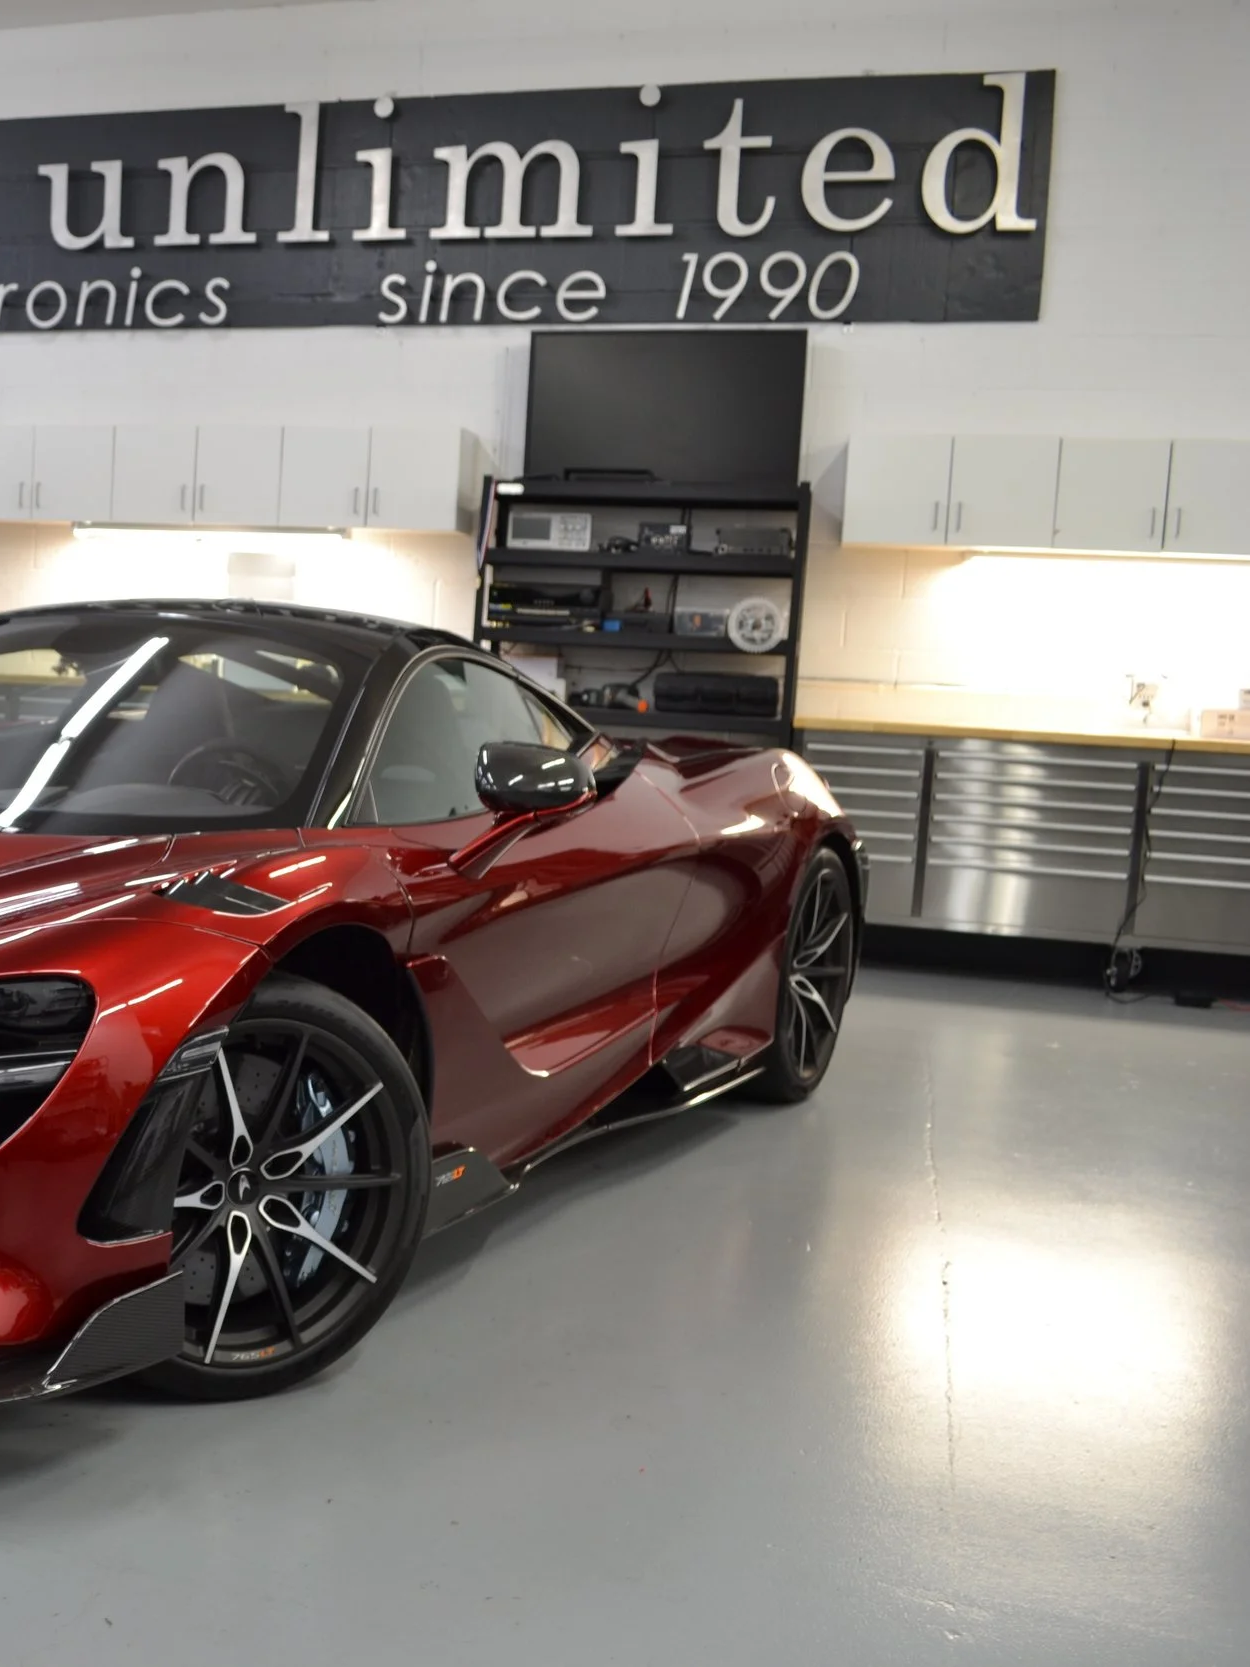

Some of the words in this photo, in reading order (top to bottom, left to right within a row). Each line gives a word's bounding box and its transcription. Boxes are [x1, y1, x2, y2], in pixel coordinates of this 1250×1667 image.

[38, 72, 1037, 250] unlimited
[377, 258, 607, 326] since
[675, 249, 861, 323] 1990
